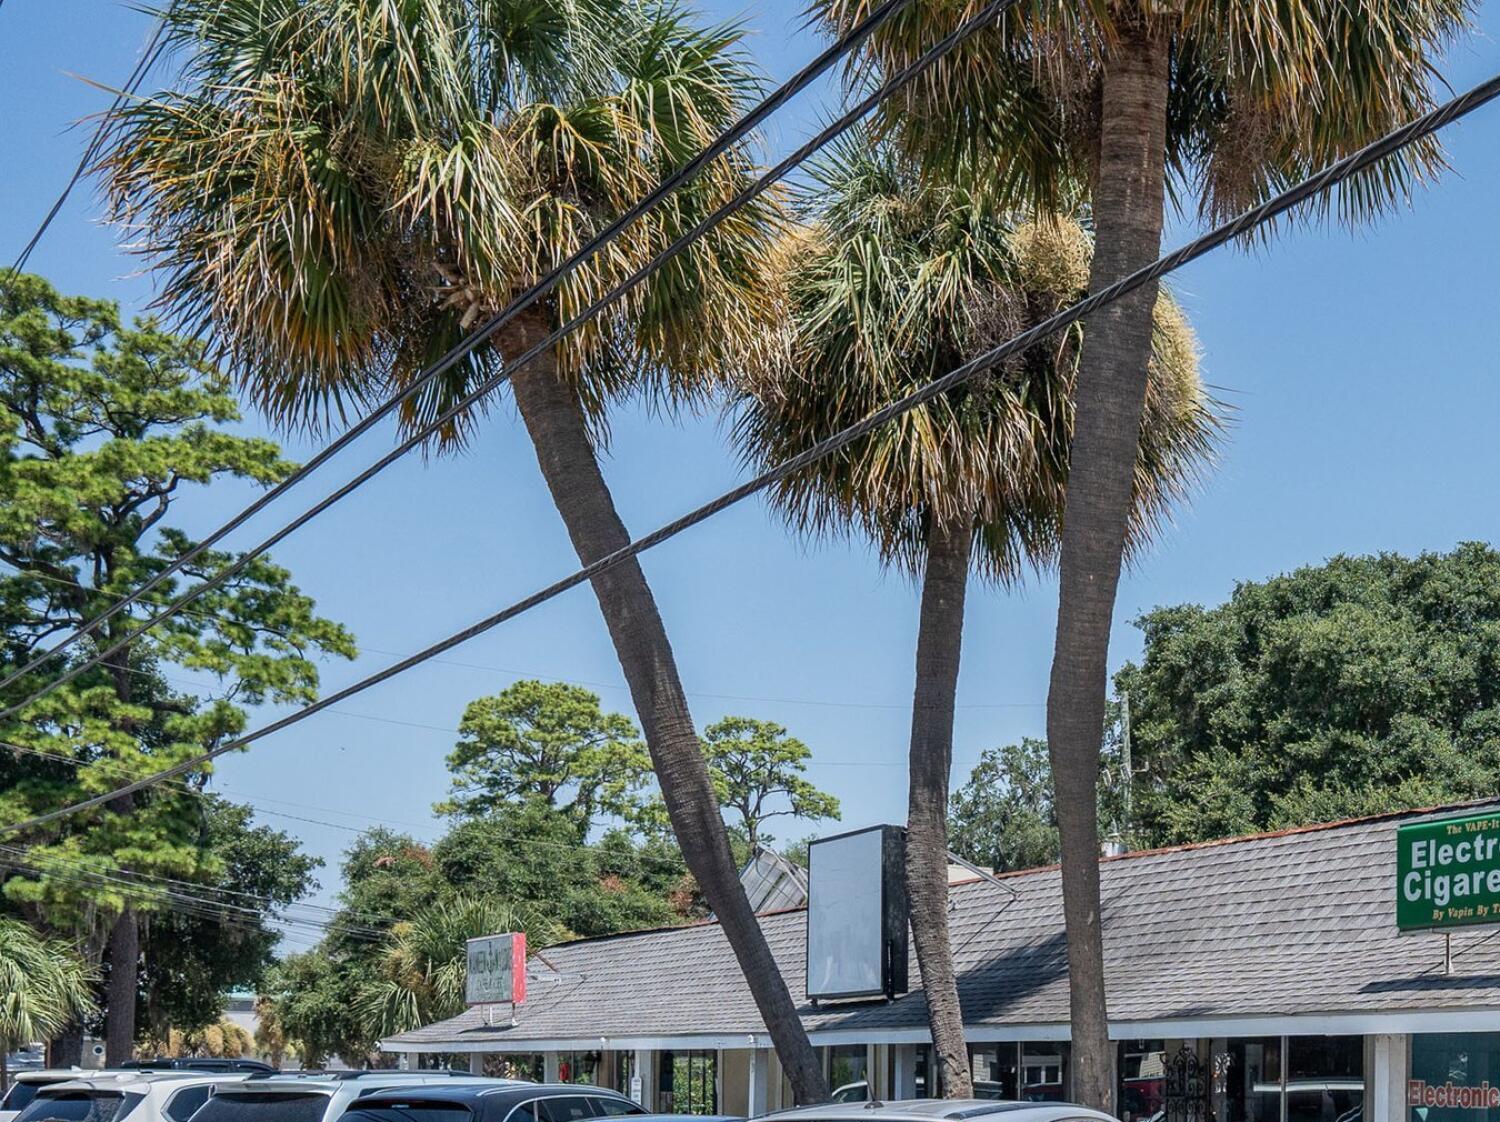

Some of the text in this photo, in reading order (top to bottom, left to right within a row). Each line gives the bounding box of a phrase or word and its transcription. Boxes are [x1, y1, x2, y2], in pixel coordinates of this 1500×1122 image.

[1446, 824, 1462, 835] The
[1432, 909, 1445, 921] By
[1448, 906, 1474, 920] Vapin
[1477, 904, 1490, 916] By
[1407, 1079, 1500, 1109] Electronic
